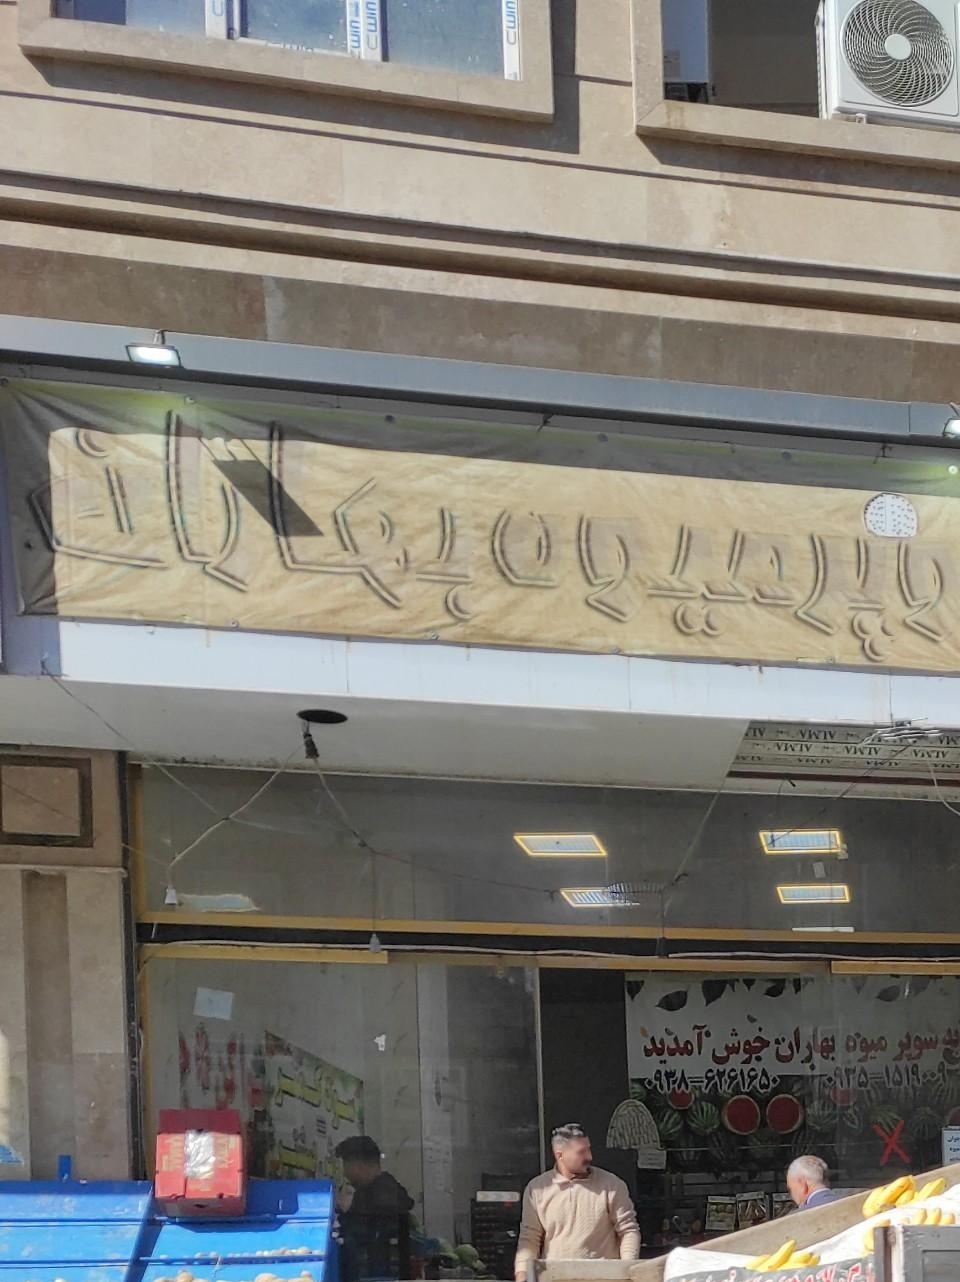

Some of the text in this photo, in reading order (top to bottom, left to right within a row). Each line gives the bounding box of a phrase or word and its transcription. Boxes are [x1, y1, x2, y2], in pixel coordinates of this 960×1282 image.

[643, 1024, 707, 1065] آمدید
[712, 1027, 771, 1065] خوش
[775, 1026, 836, 1064] بهاران
[846, 1034, 888, 1062] میوه
[893, 1032, 938, 1062] سوپر
